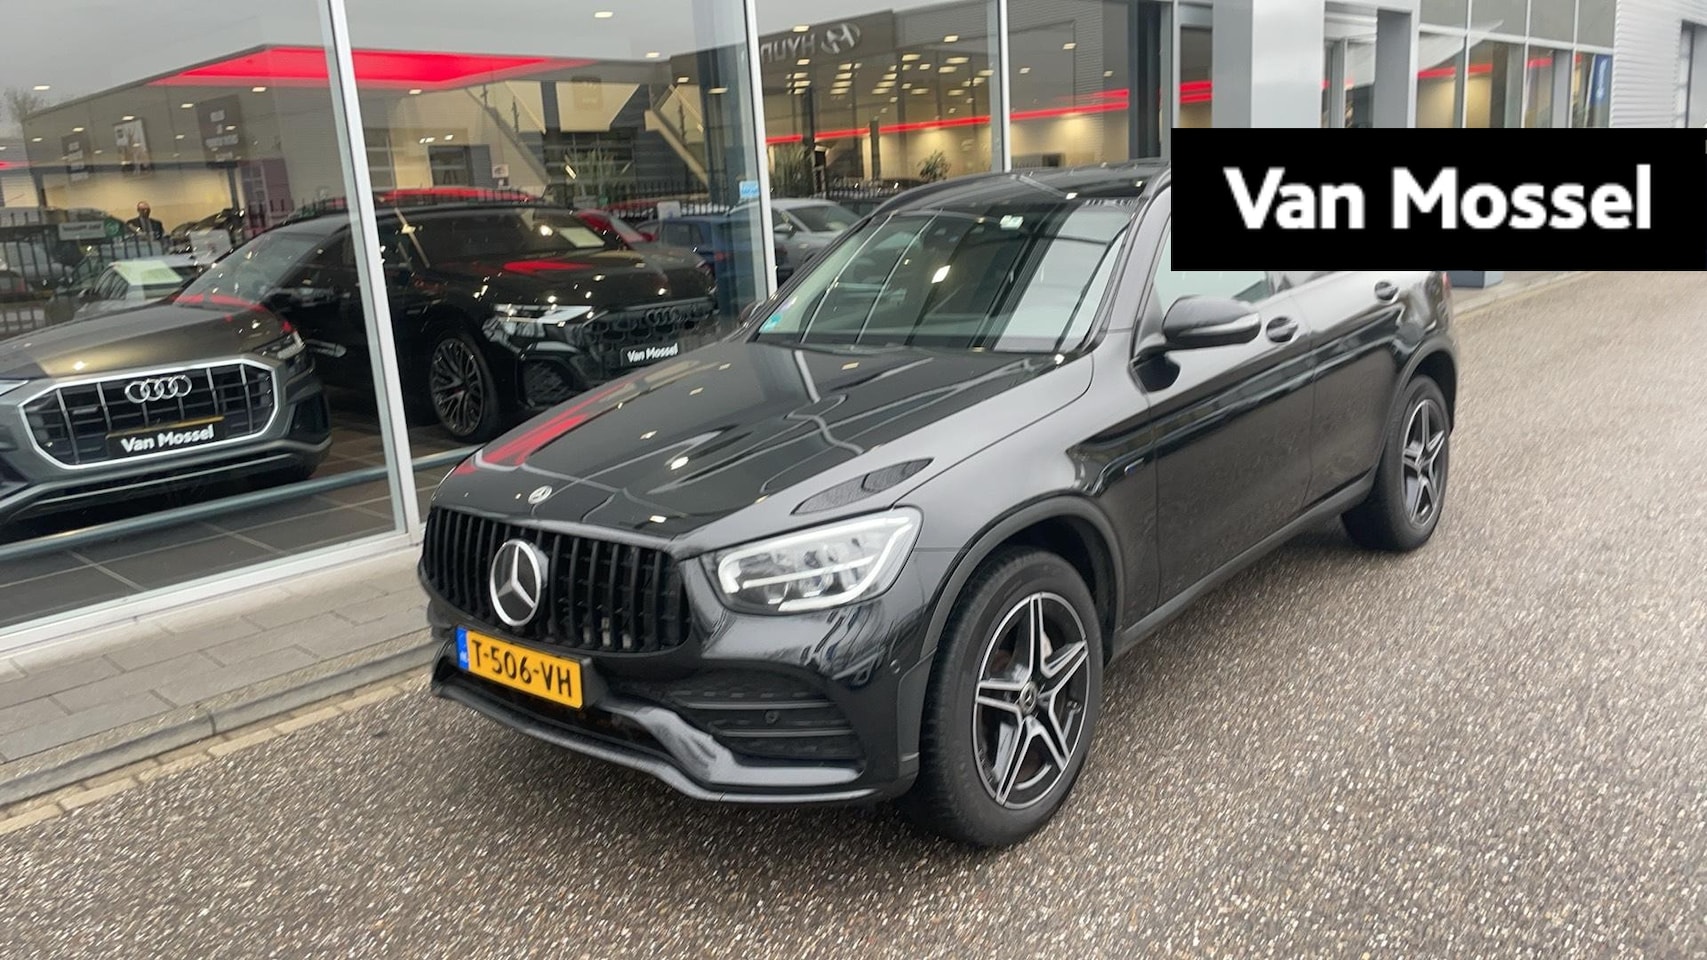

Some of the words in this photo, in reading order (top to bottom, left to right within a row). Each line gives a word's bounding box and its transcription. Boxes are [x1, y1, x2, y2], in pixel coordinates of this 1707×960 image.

[627, 350, 645, 362] Van
[646, 343, 678, 359] Mossel
[121, 437, 155, 452] Van
[157, 425, 214, 446] Mossel
[472, 639, 572, 697] T-506-VH
